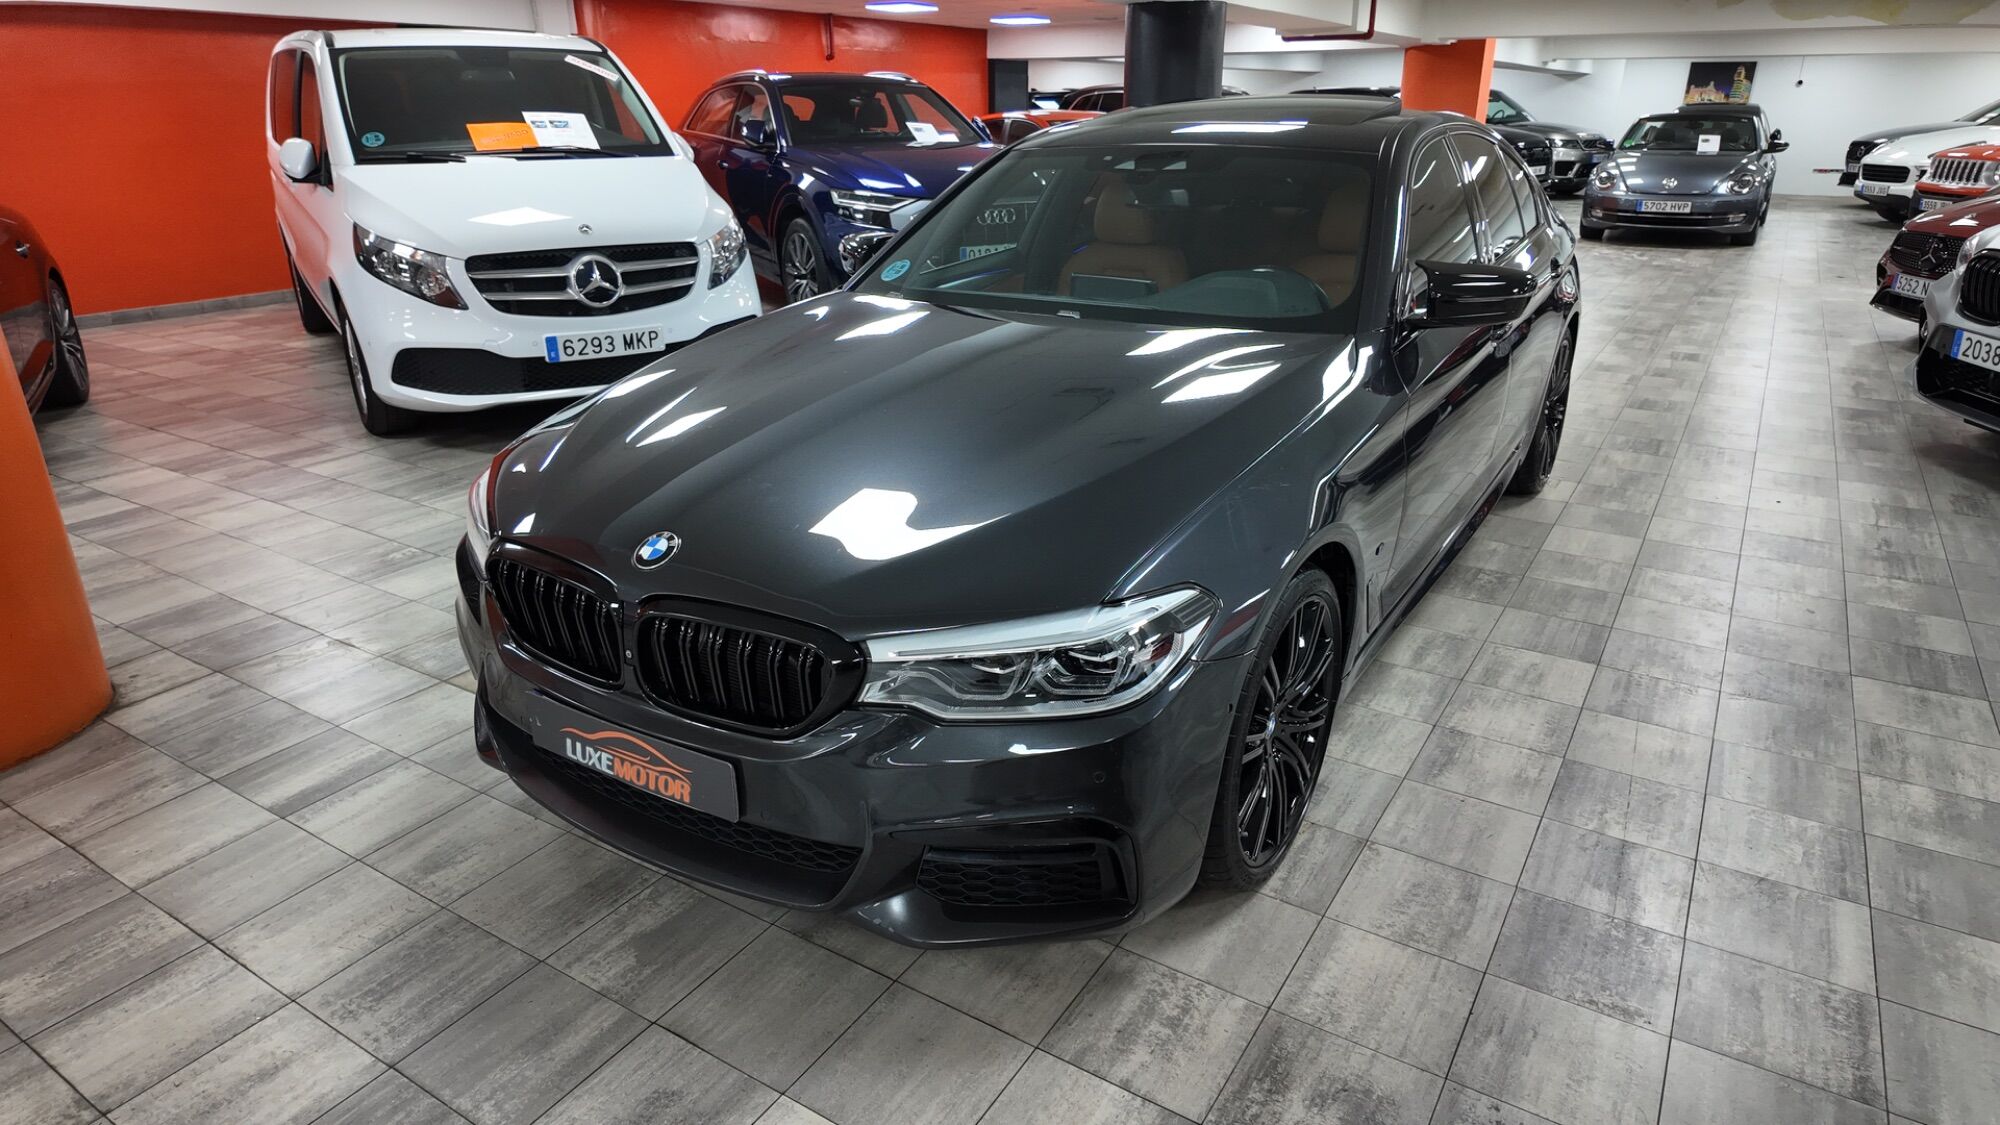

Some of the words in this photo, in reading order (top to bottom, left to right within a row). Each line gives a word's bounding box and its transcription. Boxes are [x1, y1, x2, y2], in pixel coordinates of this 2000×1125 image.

[1644, 201, 1668, 211] 5702
[1670, 202, 1689, 211] HVP
[1897, 276, 1920, 294] 5252
[563, 335, 616, 357] 6293
[623, 330, 659, 352] MKP
[1962, 337, 2000, 366] 2038
[566, 737, 691, 805] LUXEMOTOR
